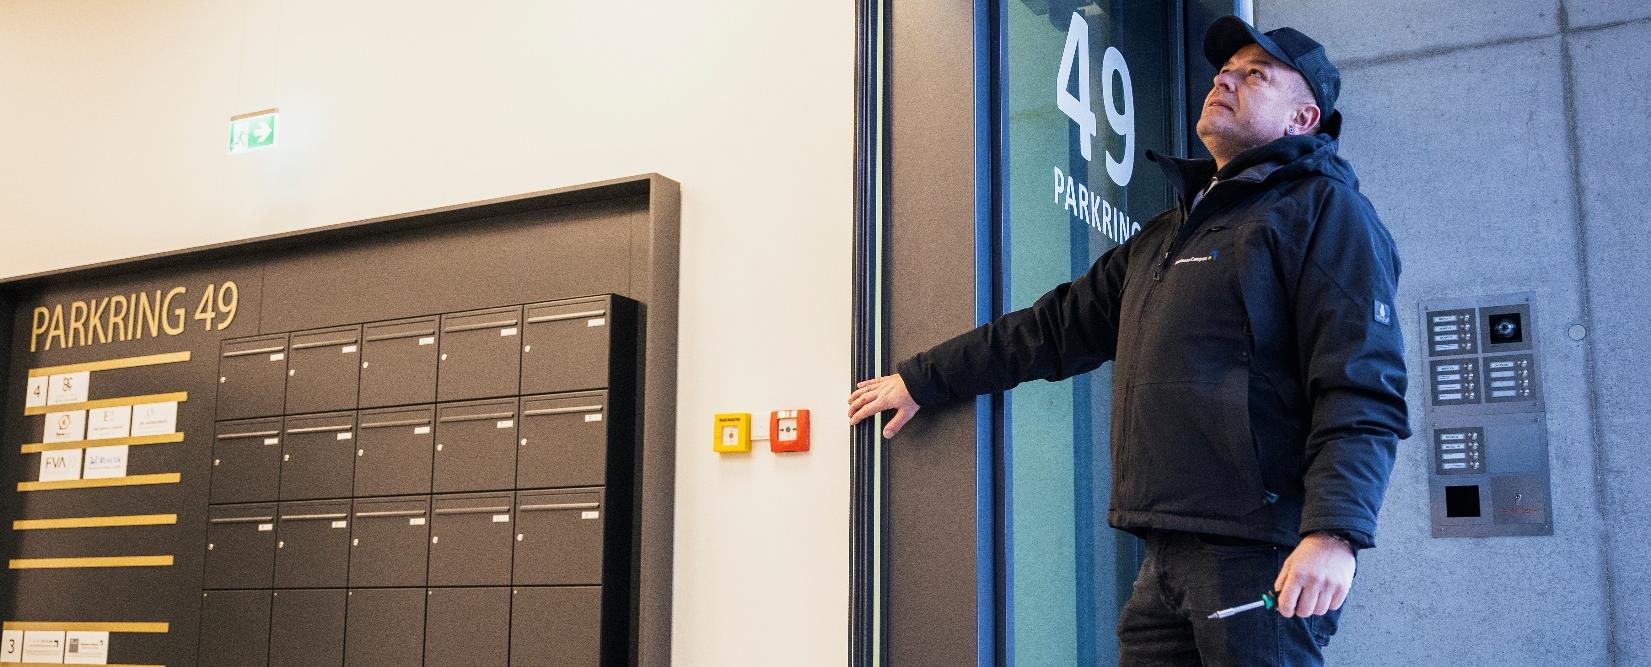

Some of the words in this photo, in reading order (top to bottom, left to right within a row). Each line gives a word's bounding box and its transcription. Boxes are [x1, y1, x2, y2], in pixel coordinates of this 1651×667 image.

[1056, 11, 1135, 187] 49
[30, 286, 187, 352] PARKRING
[194, 281, 239, 331] 49
[33, 384, 41, 398] 4
[7, 639, 16, 654] 3
